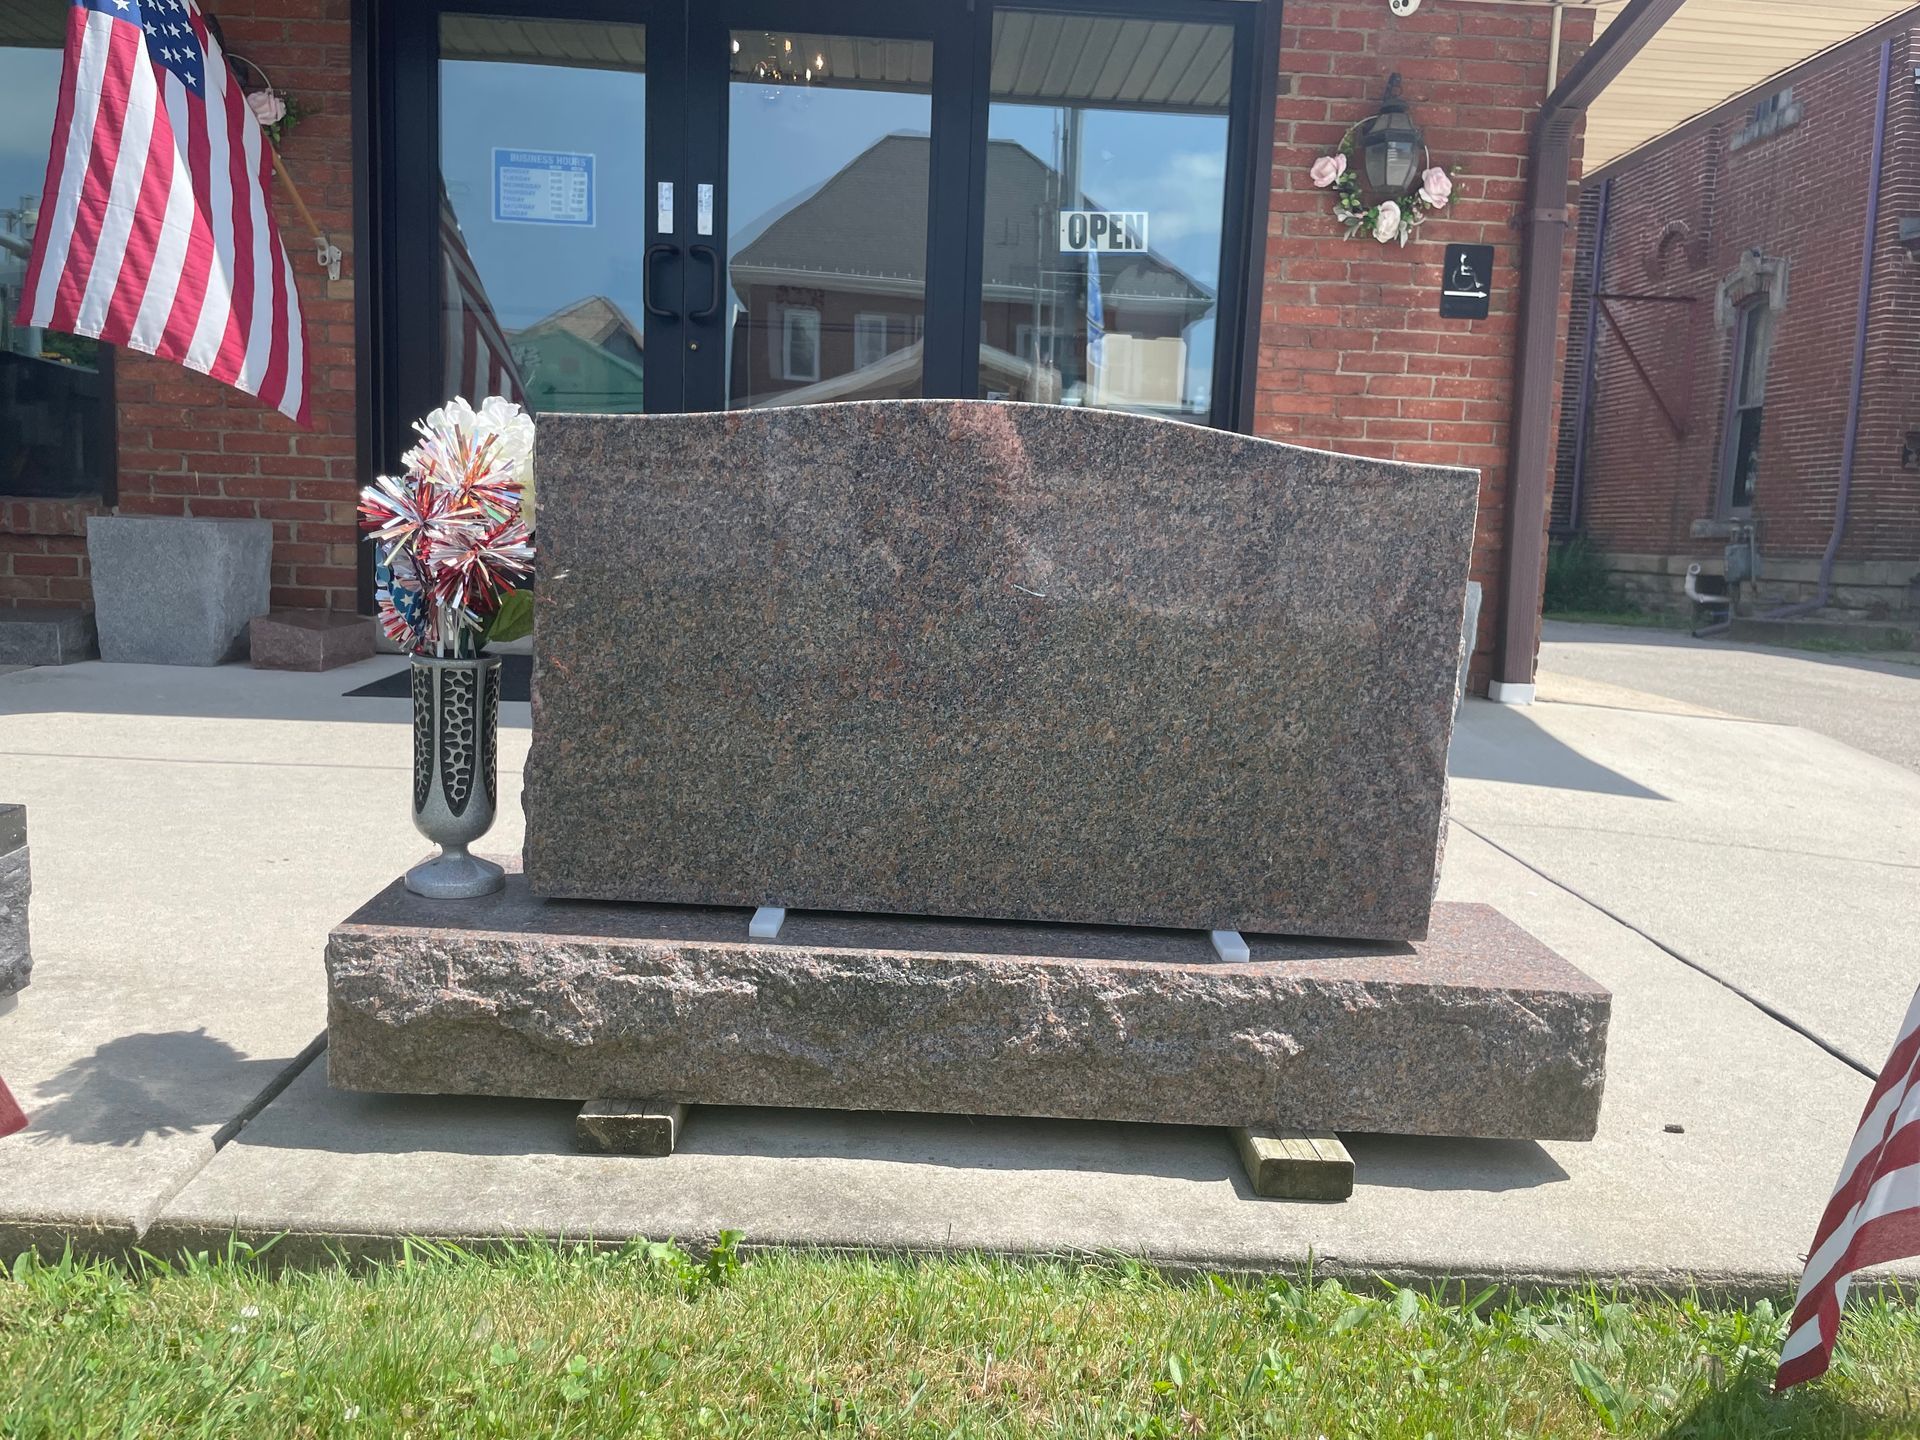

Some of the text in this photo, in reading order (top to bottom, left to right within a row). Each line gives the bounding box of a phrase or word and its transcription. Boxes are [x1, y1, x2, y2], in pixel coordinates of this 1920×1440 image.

[510, 153, 586, 167] BUSINESS HOURS
[1068, 213, 1144, 249] OPEN
